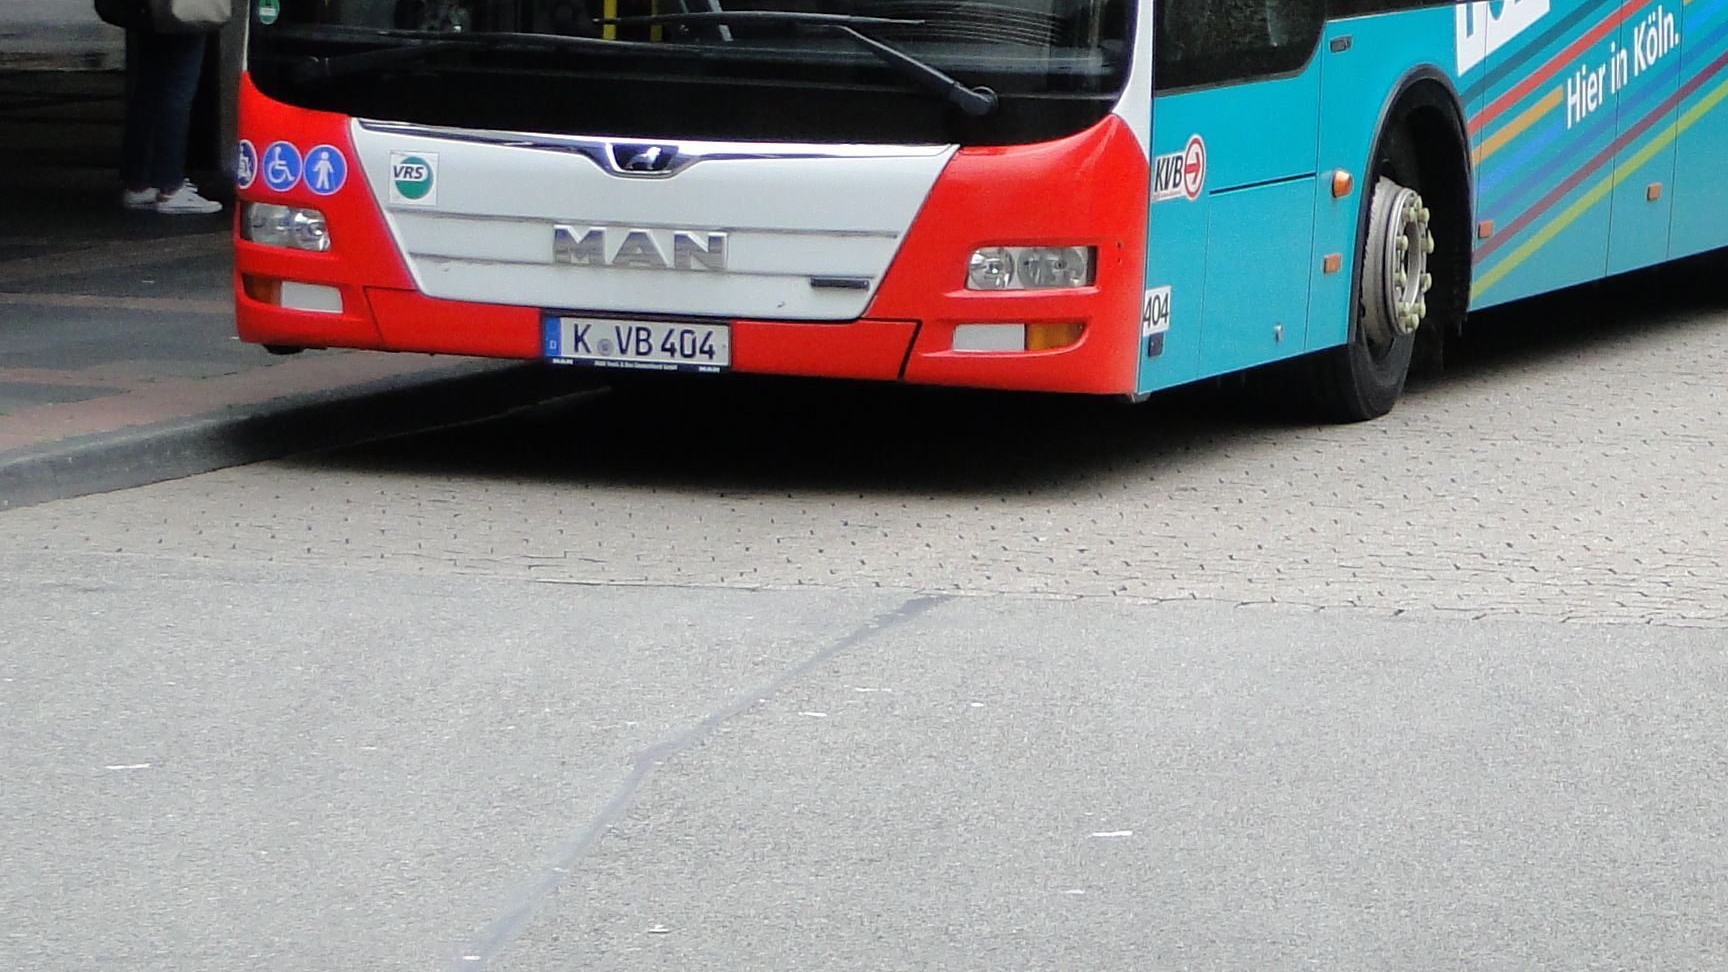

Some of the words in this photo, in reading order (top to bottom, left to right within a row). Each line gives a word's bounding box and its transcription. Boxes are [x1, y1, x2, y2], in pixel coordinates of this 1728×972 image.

[1566, 67, 1608, 130] Hier
[1611, 42, 1629, 94] in
[1632, 2, 1680, 74] Köln.
[392, 164, 425, 180] VRS
[1154, 155, 1184, 191] KVB
[554, 225, 729, 271] MAN
[1143, 292, 1170, 328] 404
[573, 322, 592, 354] K
[615, 325, 653, 356] VB
[660, 327, 716, 360] 404
